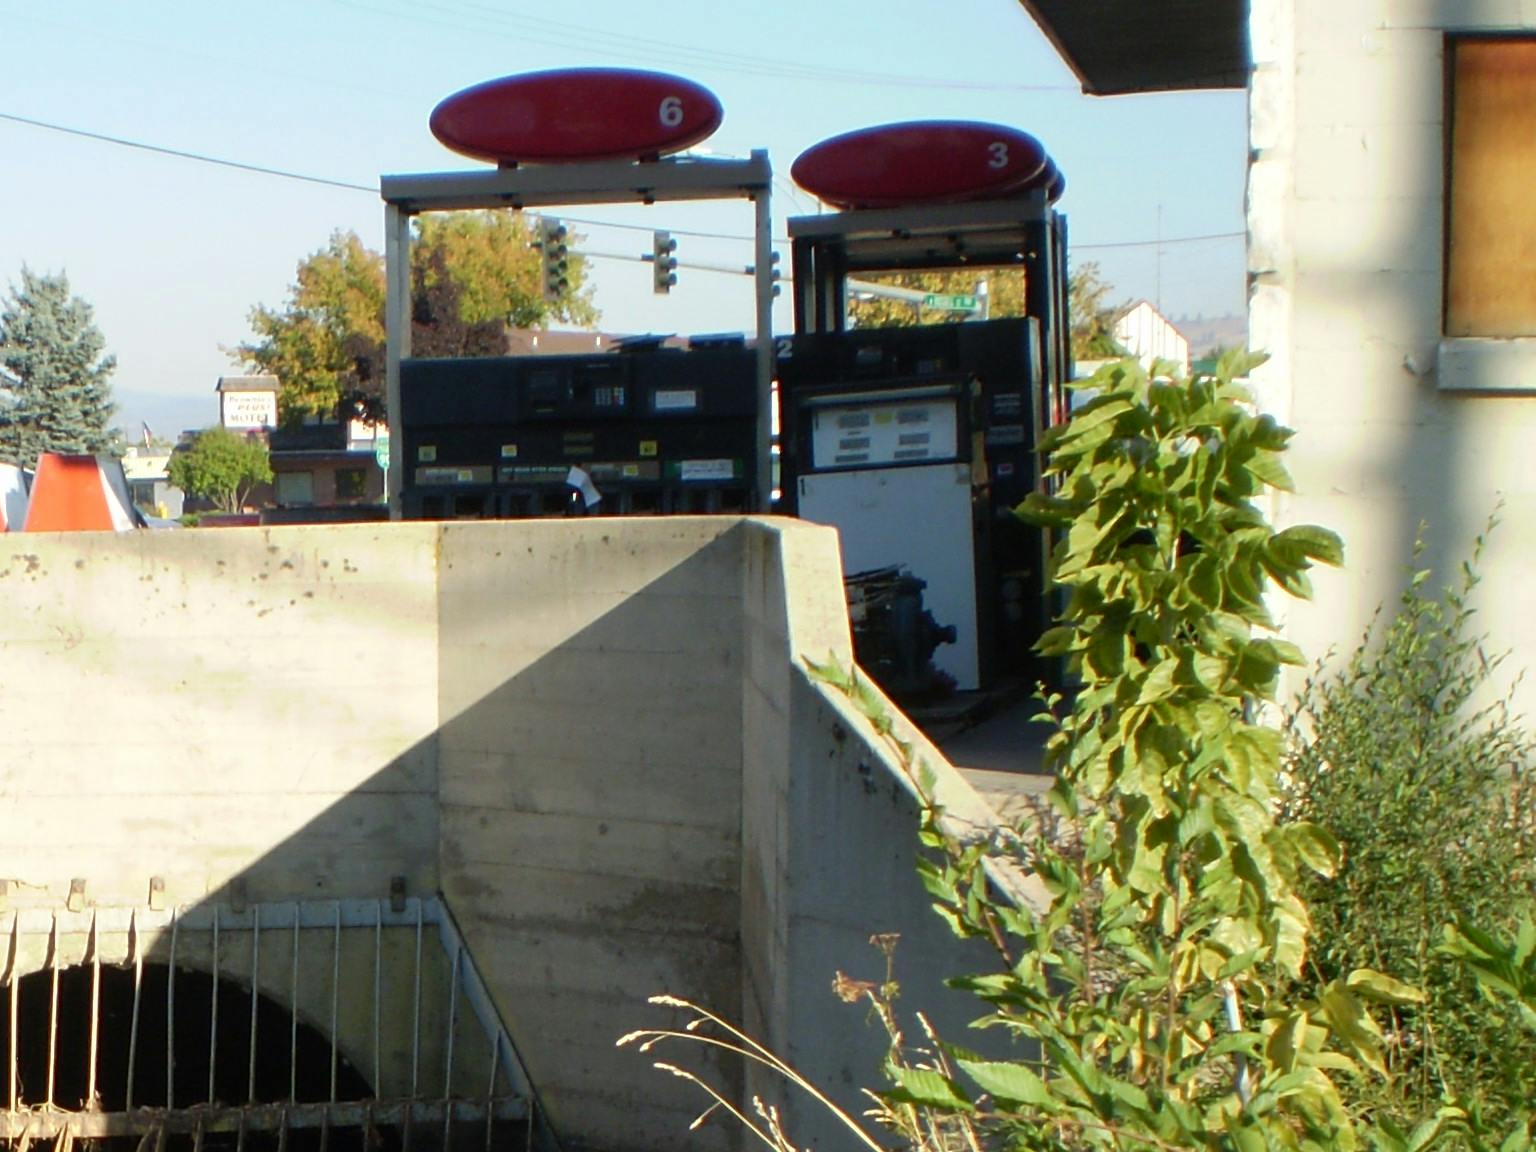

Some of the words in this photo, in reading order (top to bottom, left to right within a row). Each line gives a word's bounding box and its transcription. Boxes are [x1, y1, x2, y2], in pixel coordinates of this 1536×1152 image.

[659, 96, 683, 127] 6
[987, 142, 1009, 168] 3
[777, 339, 793, 358] 2
